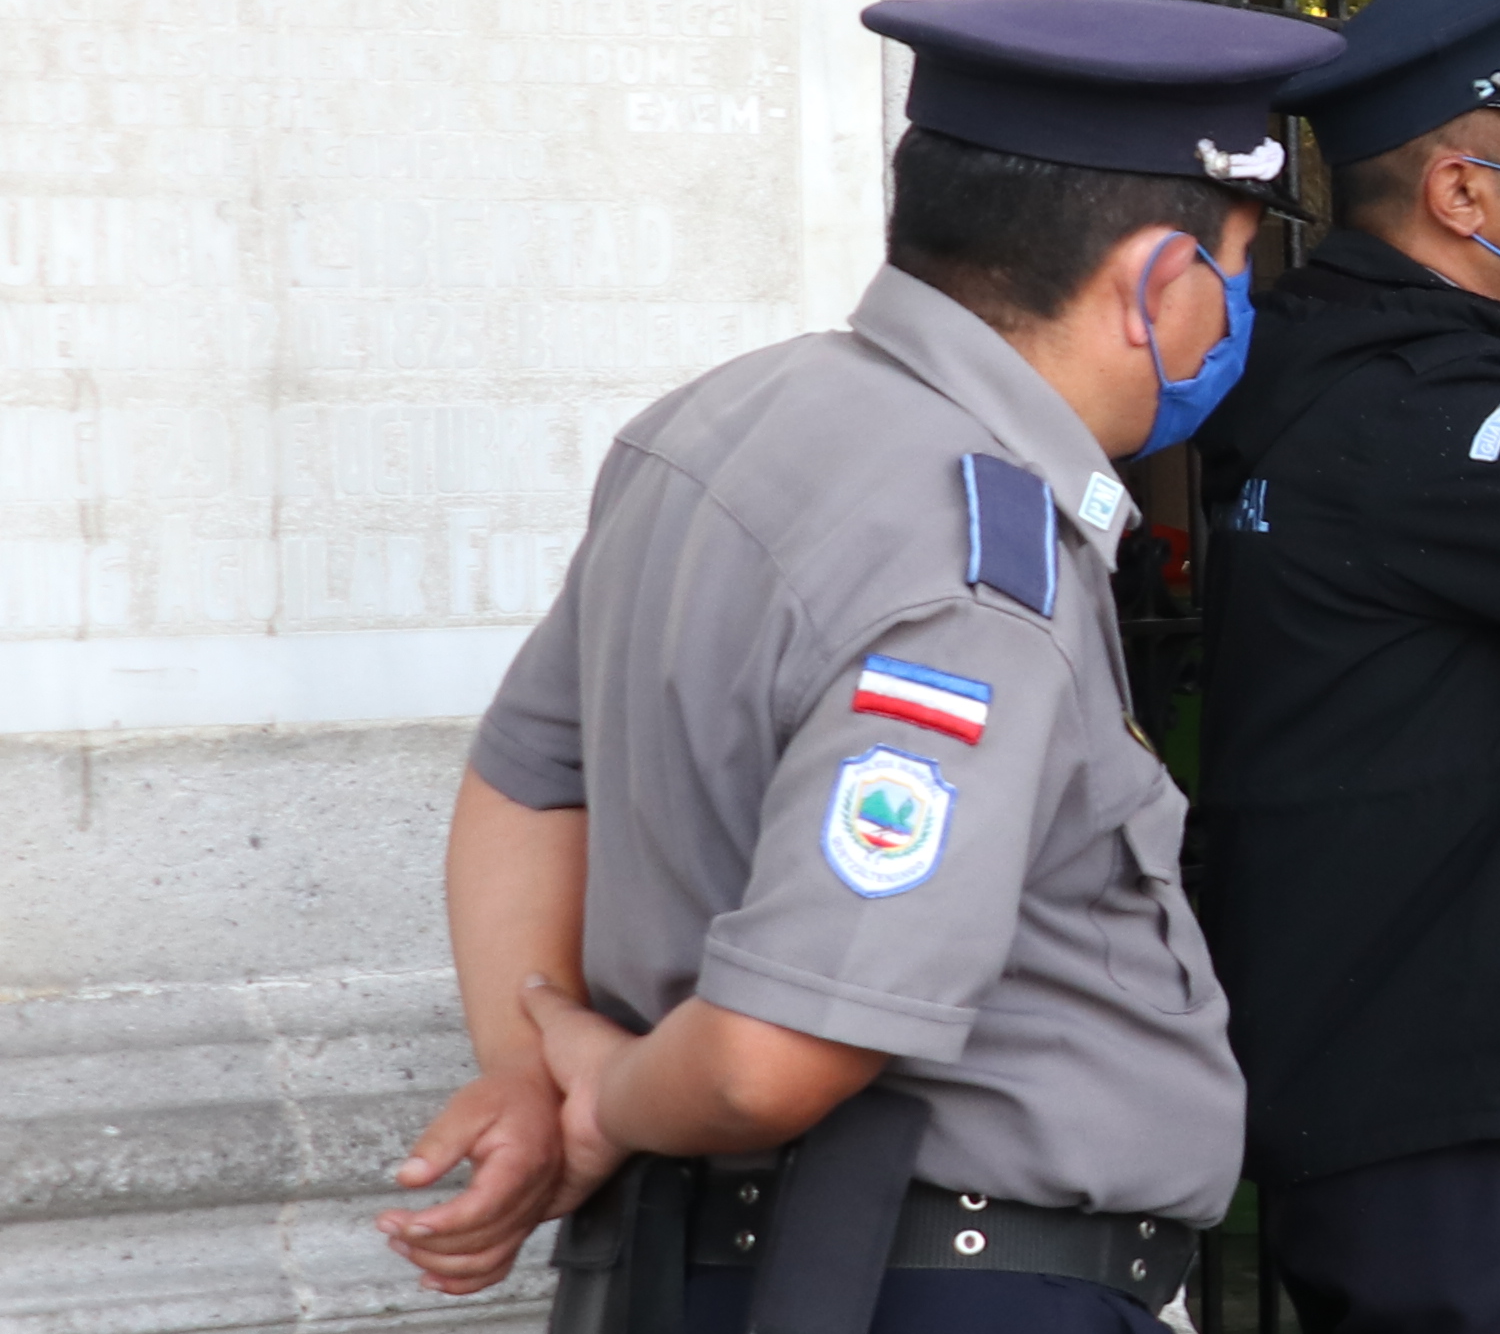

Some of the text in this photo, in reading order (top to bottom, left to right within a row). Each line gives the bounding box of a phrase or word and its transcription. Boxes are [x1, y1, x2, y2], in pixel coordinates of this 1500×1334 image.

[288, 197, 674, 289] LIBERTAD
[333, 404, 566, 499] OCTUBRE
[152, 512, 425, 625] AGUILAR
